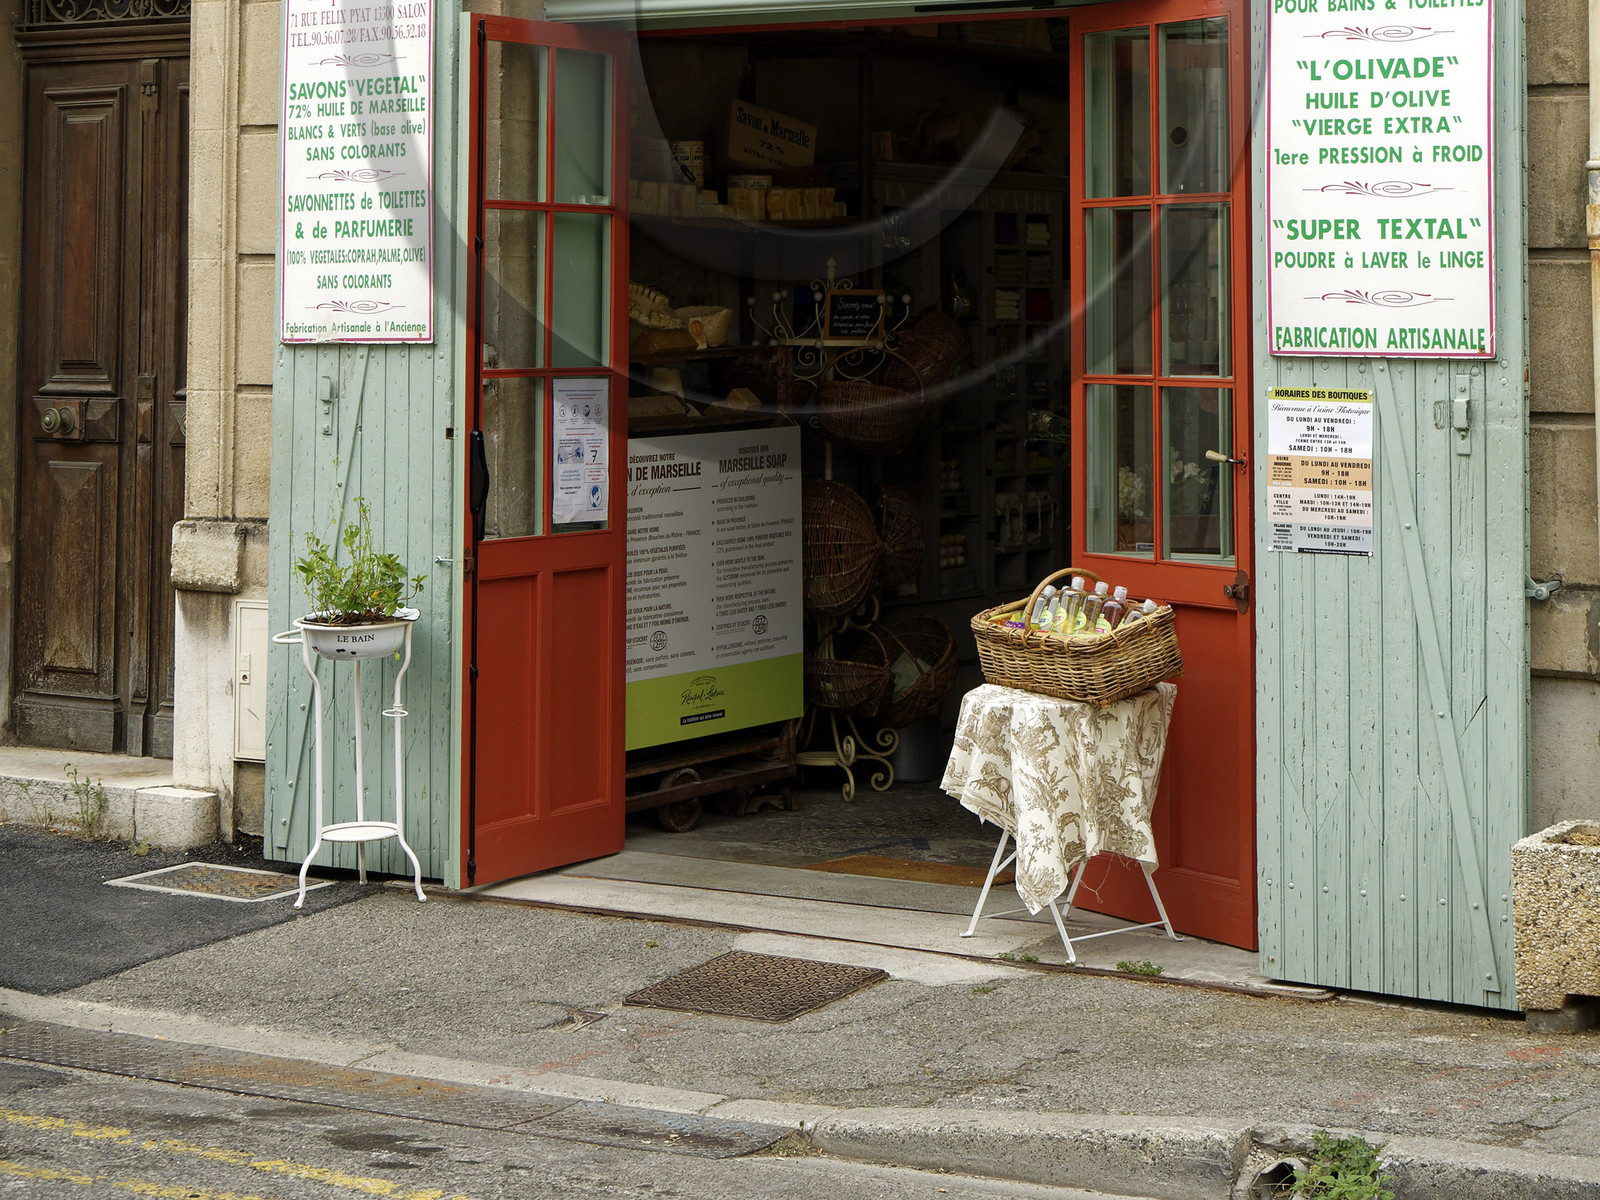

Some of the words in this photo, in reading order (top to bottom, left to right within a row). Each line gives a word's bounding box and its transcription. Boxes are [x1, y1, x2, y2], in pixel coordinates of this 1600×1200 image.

[291, 13, 298, 28] 71
[301, 12, 318, 27] RUE
[321, 9, 346, 25] FELIX
[350, 7, 370, 23] PYAT
[374, 5, 394, 21] 13300
[397, 2, 426, 19] SALON
[288, 104, 311, 119] 72%
[317, 102, 345, 117] HUILE
[351, 100, 363, 115] DE
[369, 98, 426, 114] MARSEILLE
[1306, 92, 1358, 109] HUILE
[1371, 90, 1450, 108] D'OLIVE
[288, 125, 323, 141] BLANCS
[328, 125, 335, 138] &
[340, 123, 366, 137] VERTS
[371, 120, 396, 137] (base
[401, 117, 426, 135] olive)
[736, 107, 762, 132] Savon
[770, 120, 810, 148] Marseille
[306, 146, 335, 161] SANS
[341, 142, 406, 160] COLORANTS
[759, 140, 773, 151] 72
[1274, 148, 1309, 165] 1ere
[1319, 146, 1402, 164] PRESSION
[1412, 145, 1422, 162] à
[1432, 145, 1482, 162] FROID
[288, 193, 355, 212] SAVONNETTES
[360, 192, 373, 209] de
[379, 190, 426, 209] TOILETTES
[295, 222, 304, 239] &
[312, 221, 327, 238] de
[335, 219, 413, 238] PARFUMERIE
[286, 249, 306, 266] (100%
[1274, 252, 1335, 269] POUDRE
[1344, 251, 1353, 268] à
[1362, 252, 1408, 269] LAVER
[1418, 251, 1430, 268] le
[1440, 251, 1484, 269] LINGE
[317, 275, 338, 289] SANS
[342, 274, 392, 289] COLORANTS
[286, 322, 327, 334] Fabrication
[331, 322, 371, 333] Artisanale
[376, 322, 381, 332] à
[385, 321, 426, 332] l'Ancienne
[1276, 326, 1377, 349] FABRICATION
[1387, 328, 1485, 350] ARTISANALE
[1275, 389, 1310, 398] HORAIRES
[1312, 390, 1326, 399] DES
[1328, 391, 1368, 400] BOUTIQUES
[630, 454, 658, 464] DÉCOUVREZ
[659, 453, 675, 461] NOTRE
[719, 457, 765, 474] MARSEILLE
[767, 454, 787, 469] SOAP
[636, 467, 648, 480] DE
[651, 462, 701, 480] MARSEILLE
[728, 474, 761, 489] exceptional
[763, 471, 784, 486] quality
[631, 484, 671, 498] d'exception
[352, 634, 375, 642] BAIN
